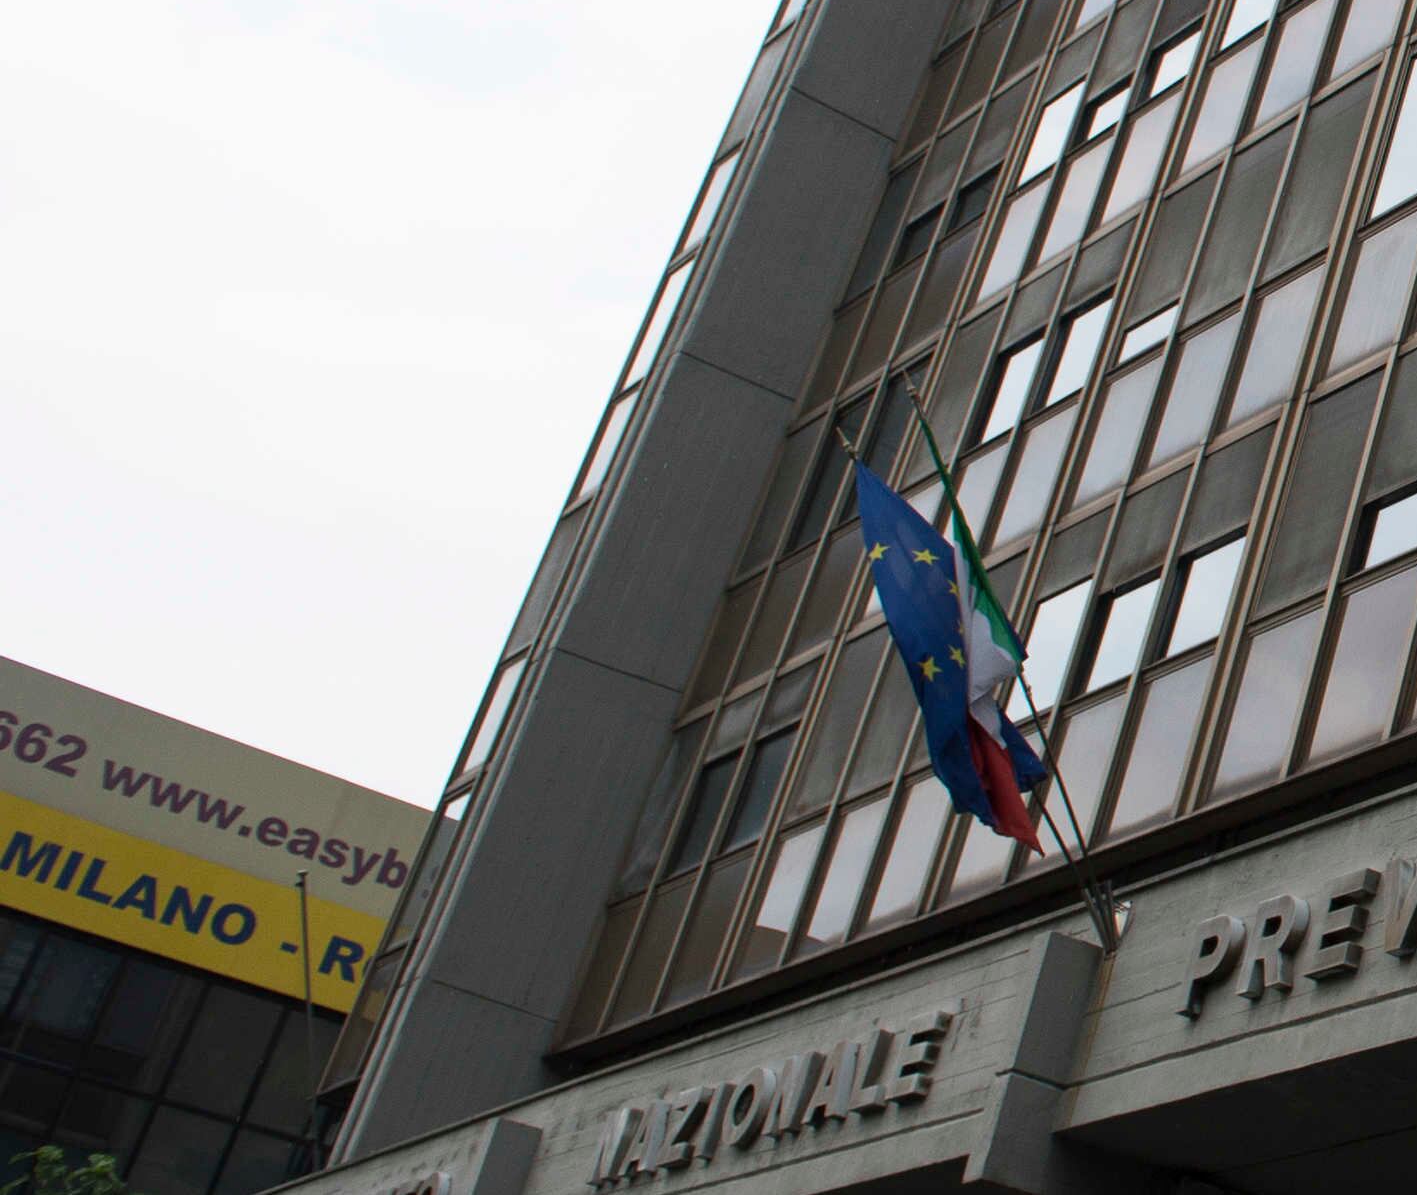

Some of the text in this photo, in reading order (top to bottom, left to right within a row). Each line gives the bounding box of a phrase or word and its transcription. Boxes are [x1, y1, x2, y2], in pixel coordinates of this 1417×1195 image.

[0, 831, 256, 946] MILANO
[318, 935, 373, 983] R
[587, 1010, 953, 1188] NAZIONALE
